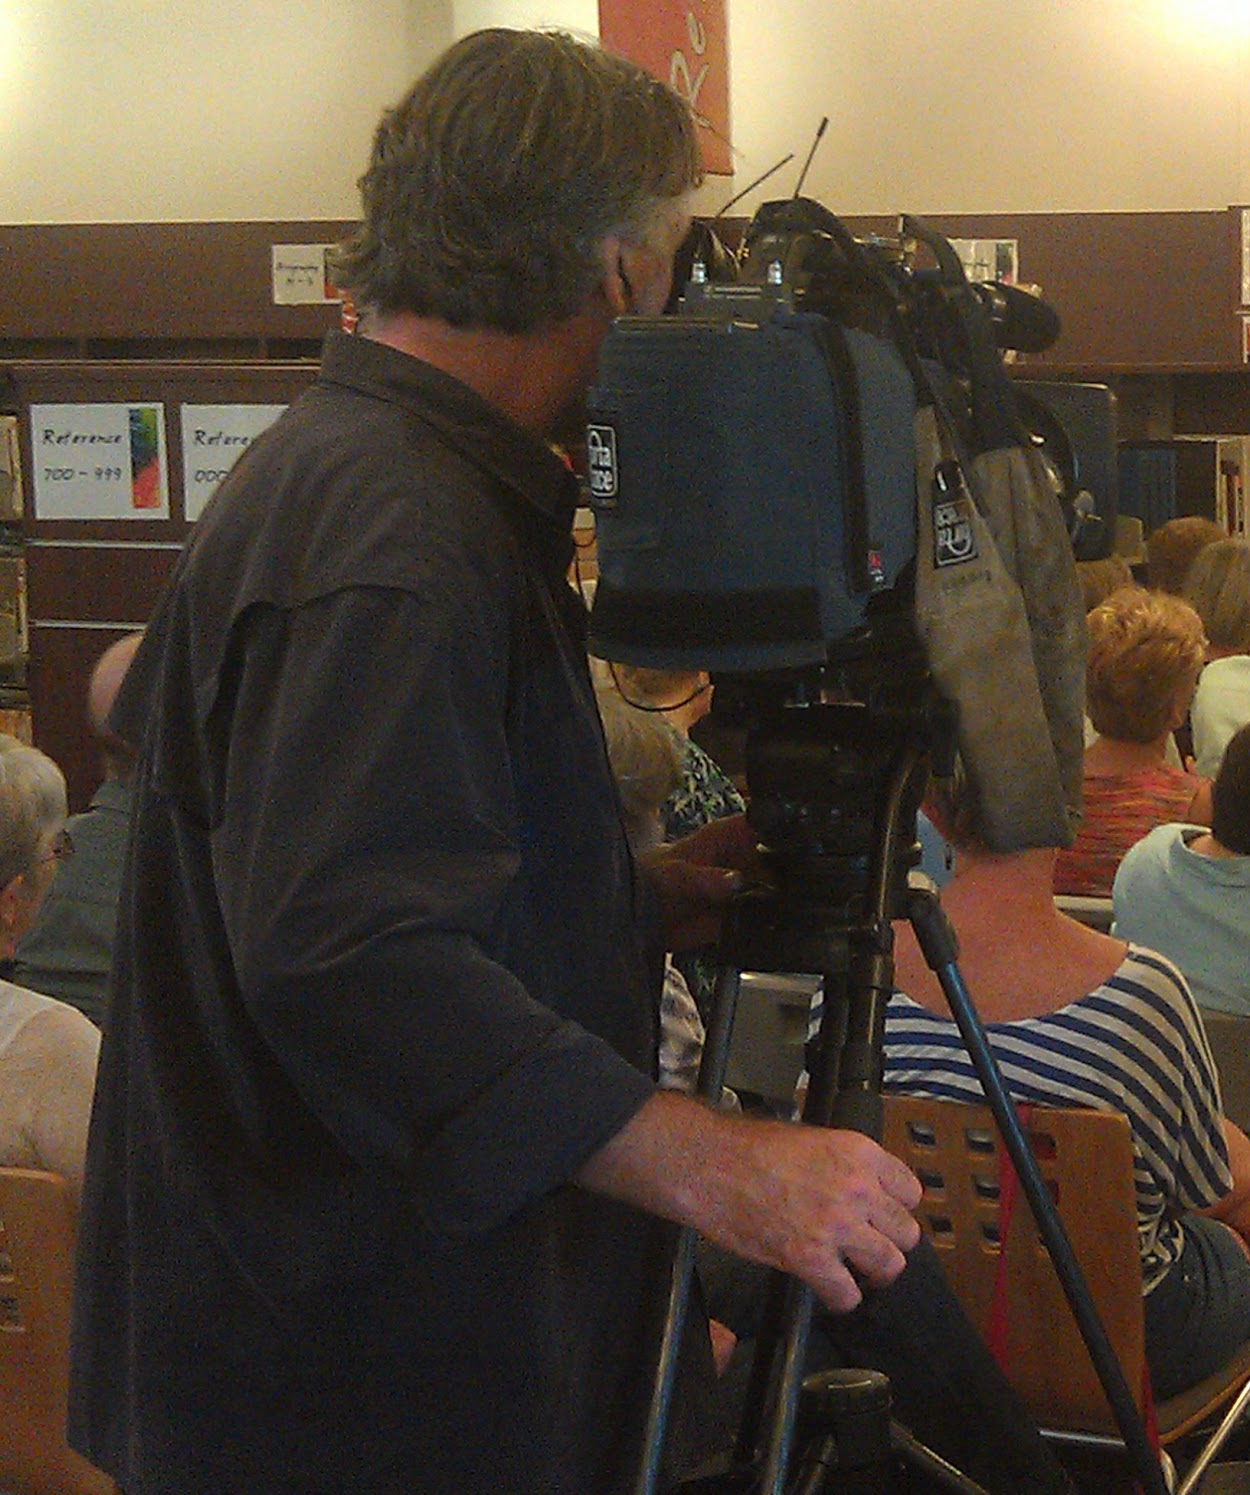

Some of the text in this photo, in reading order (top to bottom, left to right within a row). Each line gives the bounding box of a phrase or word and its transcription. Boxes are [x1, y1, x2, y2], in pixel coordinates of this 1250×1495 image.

[43, 429, 122, 445] Reference
[193, 429, 249, 445] Refere
[44, 467, 73, 481] 700
[93, 467, 122, 481] 999
